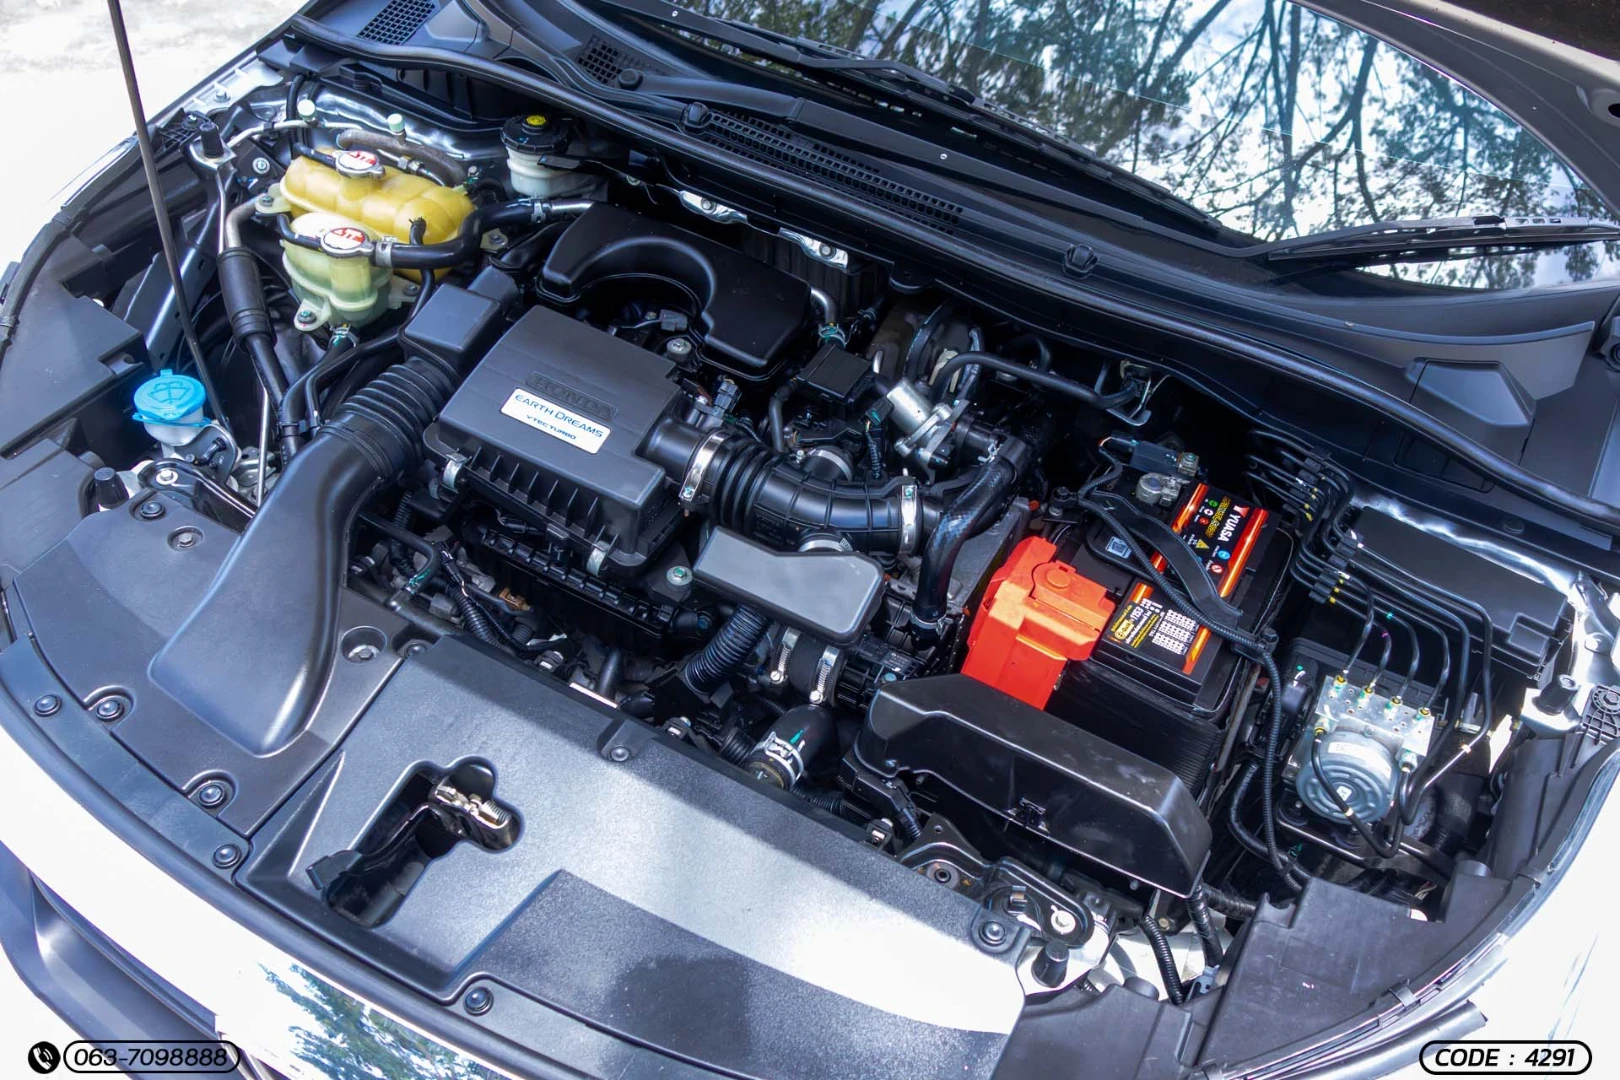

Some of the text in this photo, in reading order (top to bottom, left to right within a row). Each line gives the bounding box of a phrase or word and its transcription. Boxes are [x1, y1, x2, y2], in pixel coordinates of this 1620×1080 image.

[515, 394, 604, 438] EARTH DREAMS
[526, 414, 577, 440] VTEC TURBO
[1218, 514, 1241, 542] YUASA
